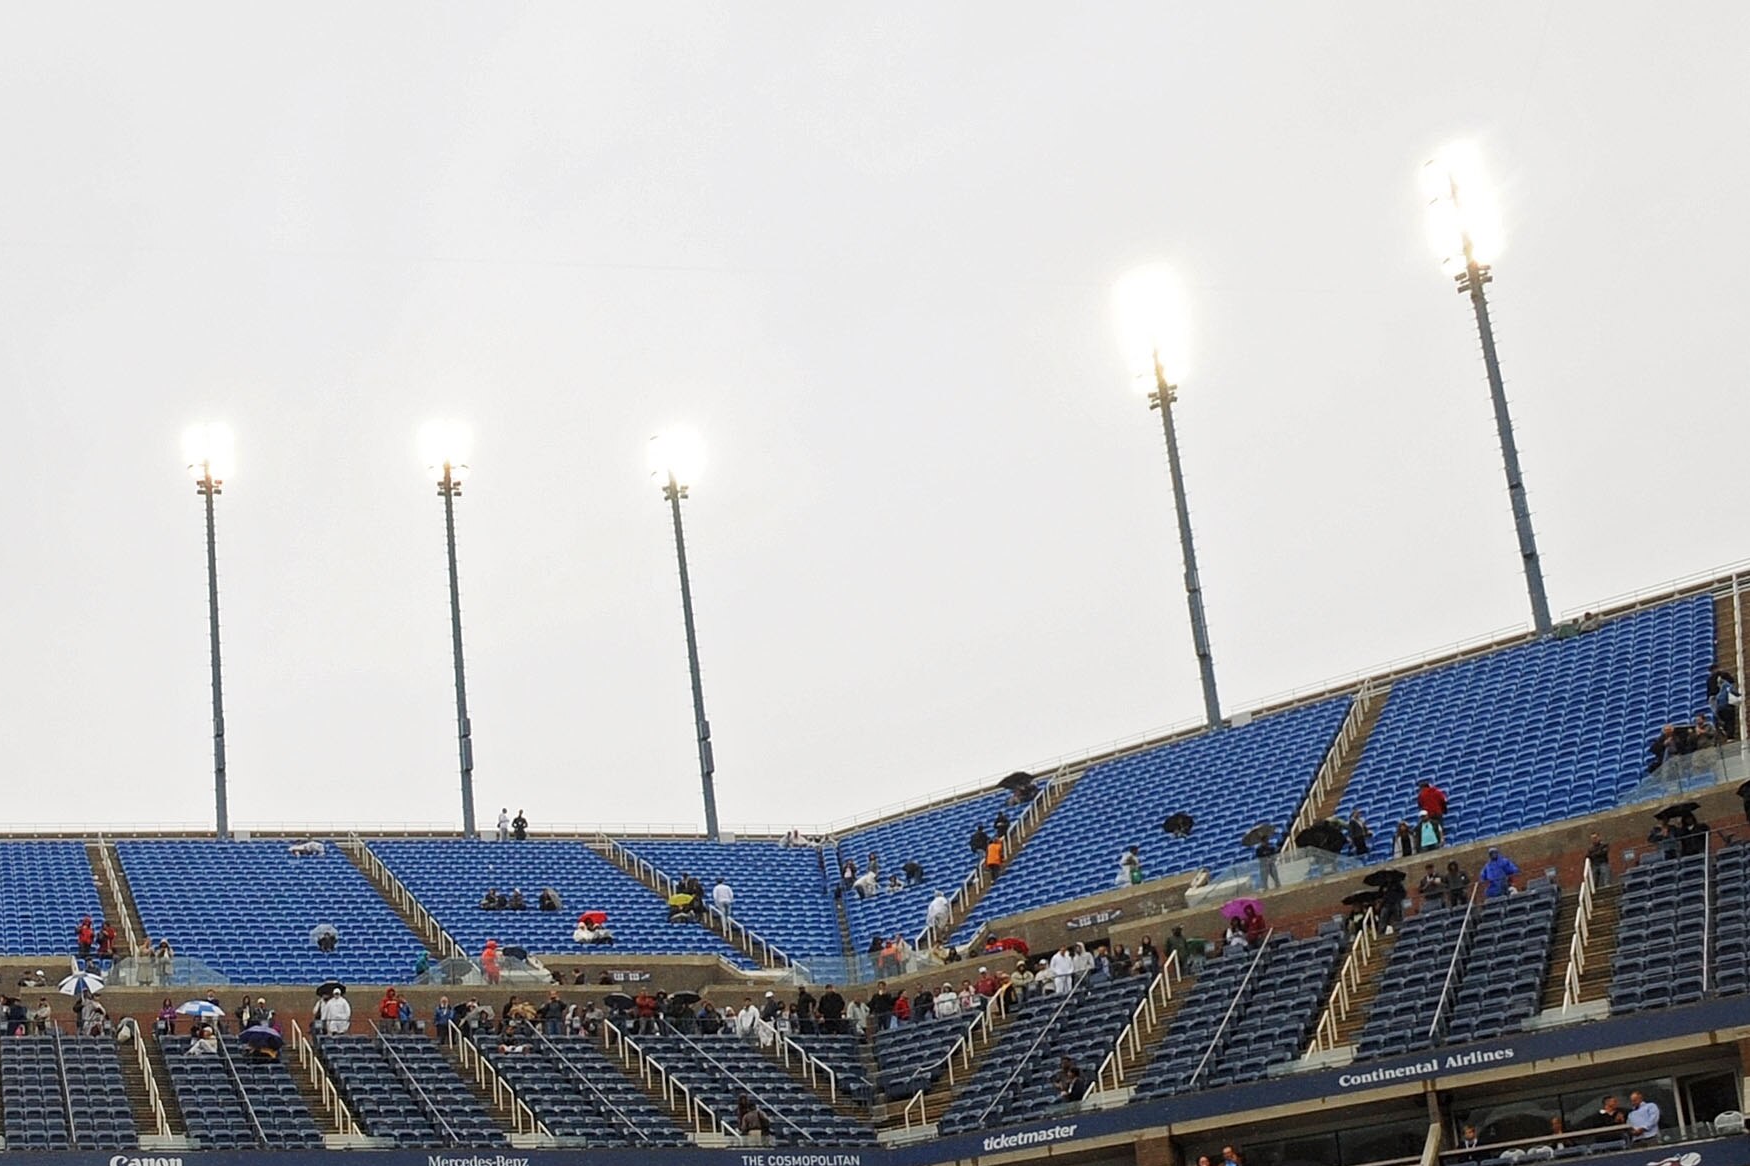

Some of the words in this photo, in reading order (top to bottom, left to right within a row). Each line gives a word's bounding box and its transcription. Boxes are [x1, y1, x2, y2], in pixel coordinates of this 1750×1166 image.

[1338, 1059, 1439, 1088] Continental
[1445, 1047, 1515, 1069] Airlines
[983, 1123, 1078, 1152] ticketmaster
[741, 1154, 765, 1166] THE
